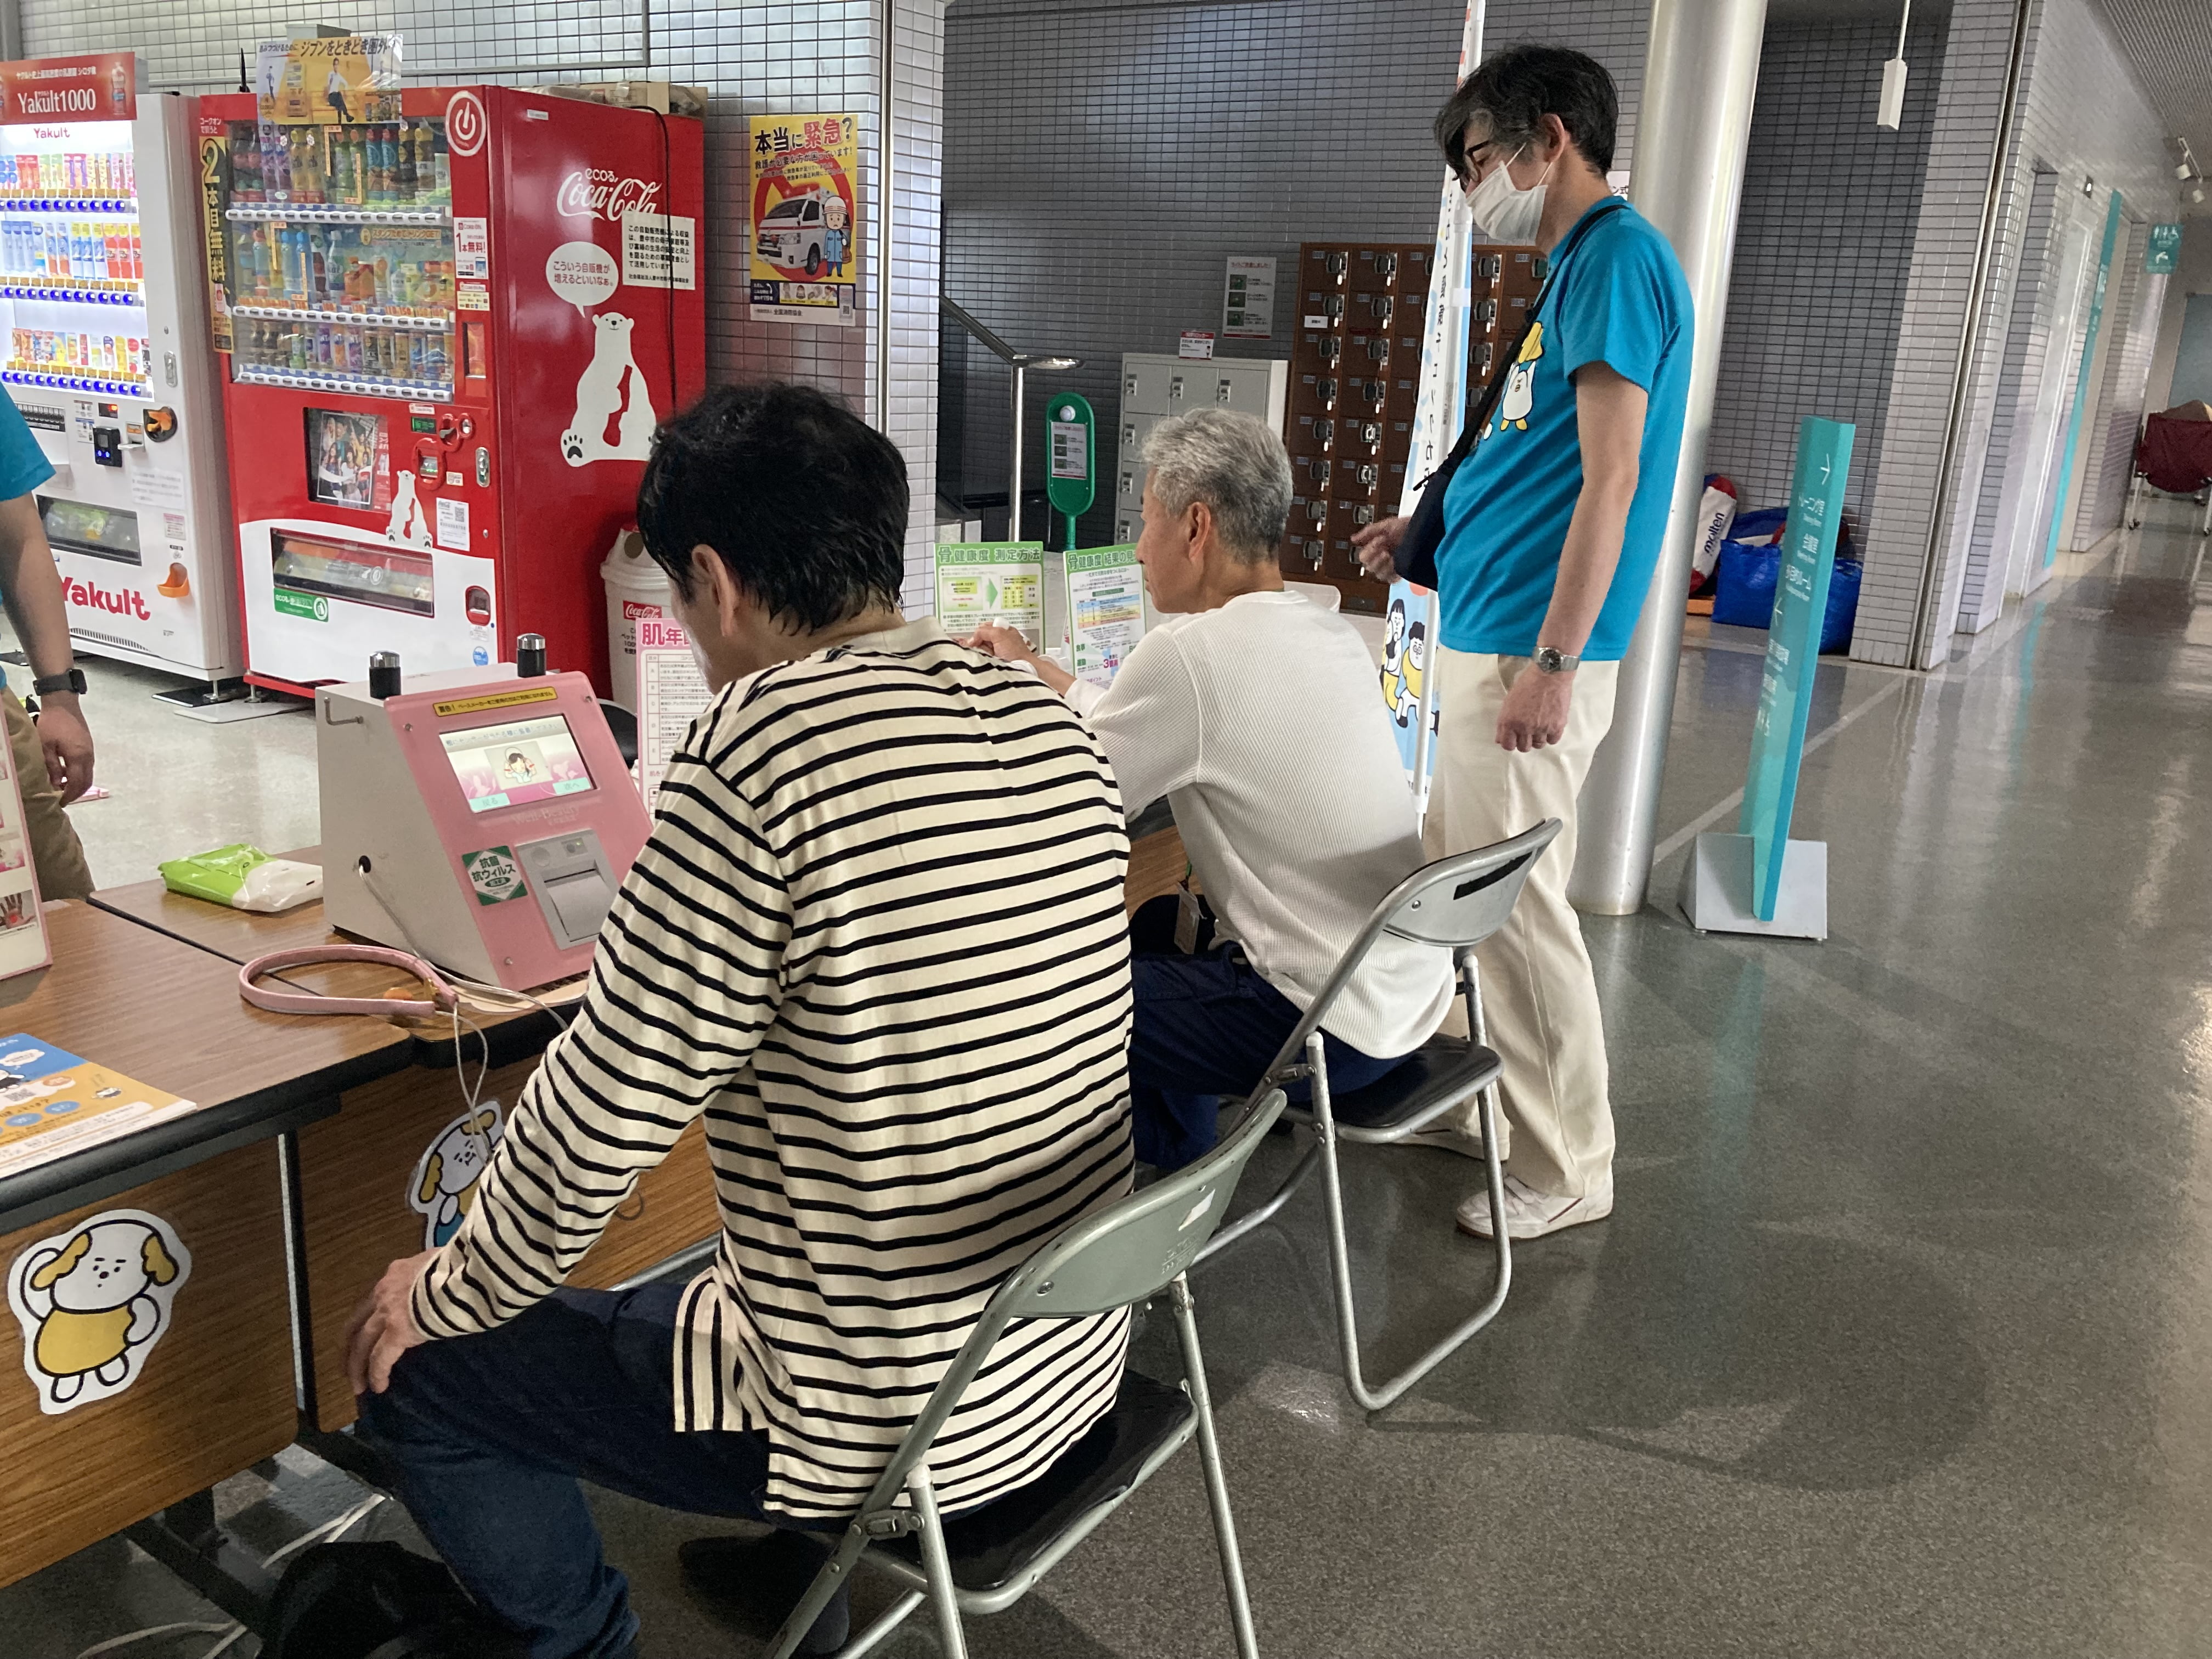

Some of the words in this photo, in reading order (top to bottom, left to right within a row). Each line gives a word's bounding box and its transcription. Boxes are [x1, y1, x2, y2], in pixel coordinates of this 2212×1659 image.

[18, 88, 97, 114] Yakult1000
[33, 127, 70, 138] Yakult
[554, 261, 610, 274] こういう自販機が
[1705, 512, 1725, 554] molten
[939, 545, 990, 563] 骨健康度
[995, 547, 1040, 562] 測定方法
[1068, 552, 1102, 571] 骨健康度
[1104, 549, 1137, 566] 結果の見
[61, 577, 150, 620] Yakult
[479, 855, 500, 869] 抗菌
